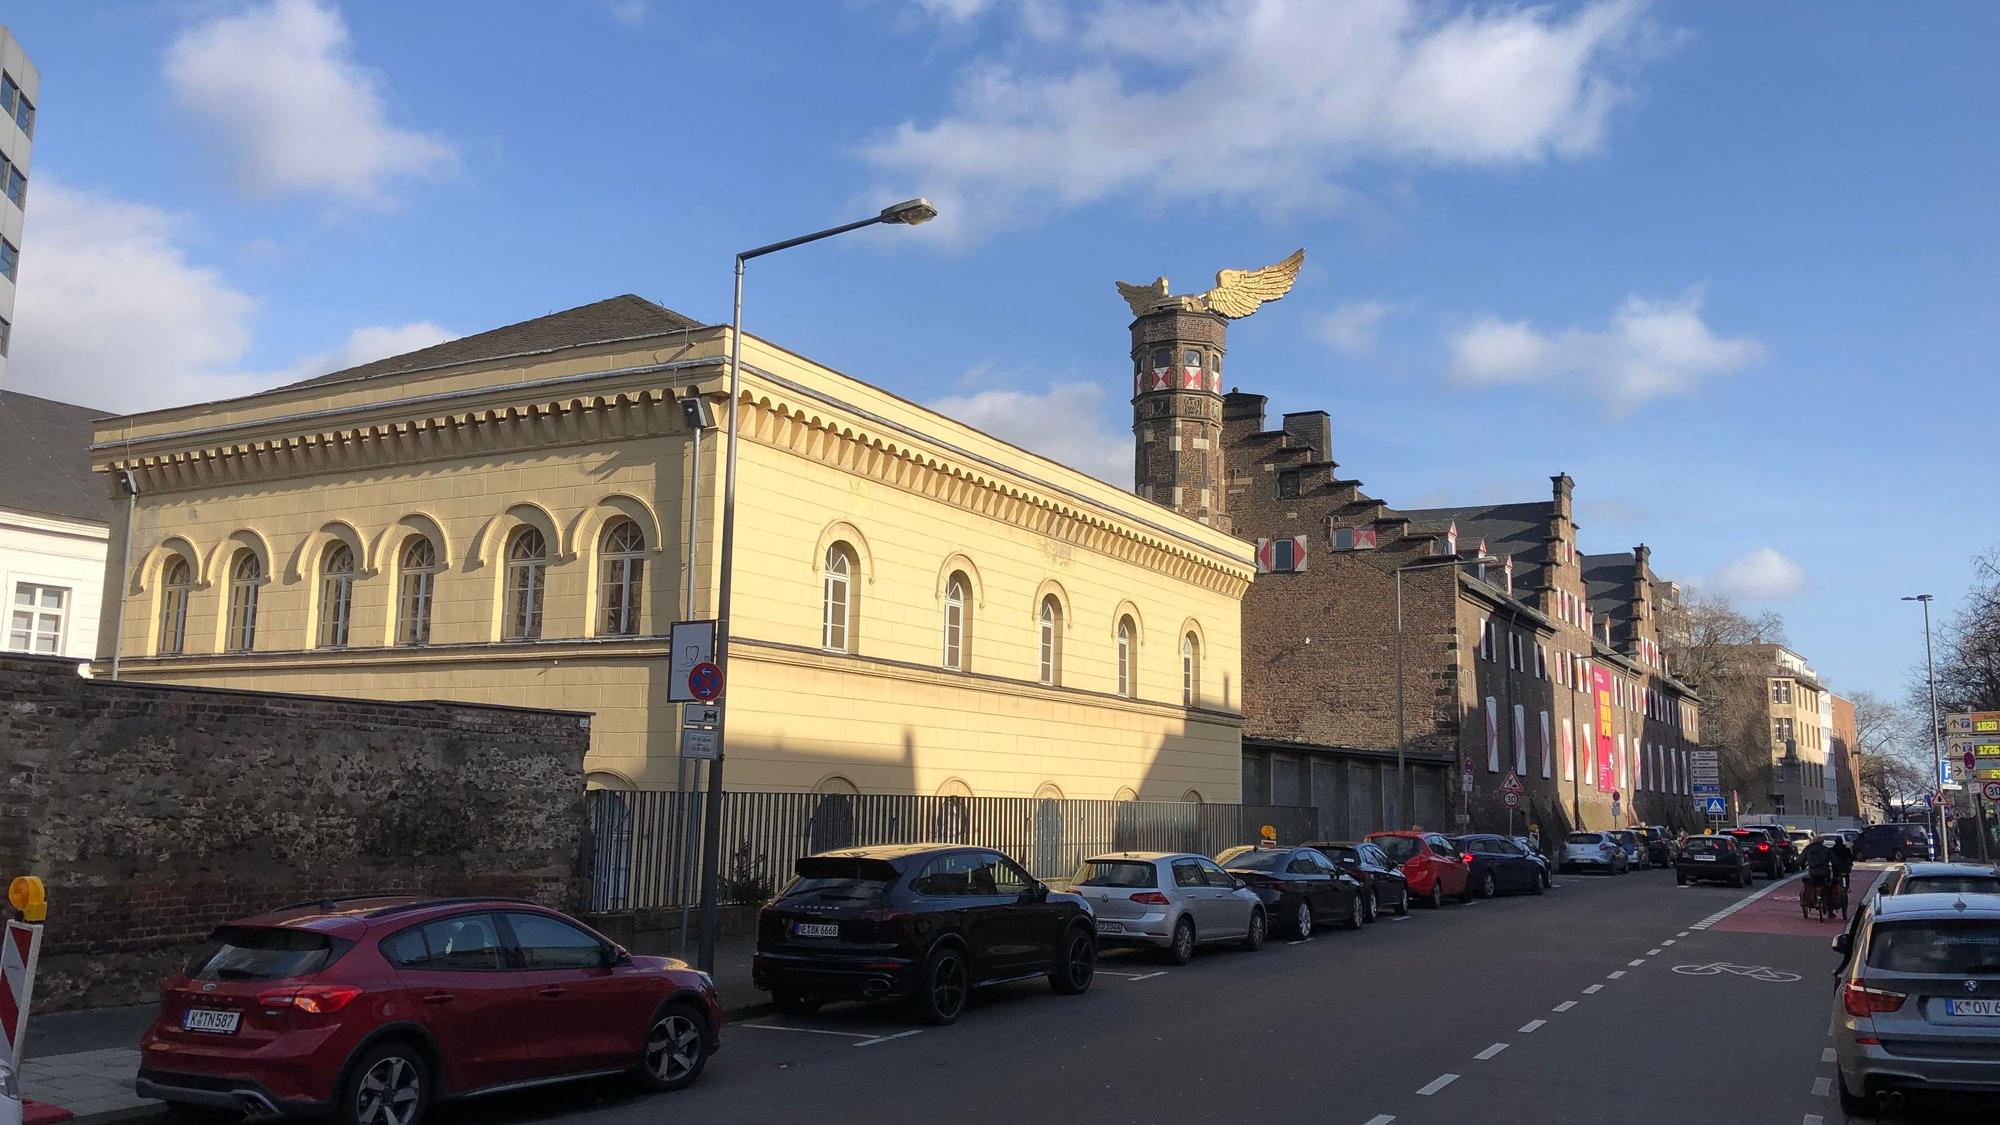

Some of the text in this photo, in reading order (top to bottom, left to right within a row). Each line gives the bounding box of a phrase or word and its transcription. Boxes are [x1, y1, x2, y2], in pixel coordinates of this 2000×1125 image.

[1977, 721, 1997, 731] 1820
[1954, 1001, 1964, 1014] K
[1973, 1001, 1991, 1014] OV
[190, 1011, 199, 1026] K
